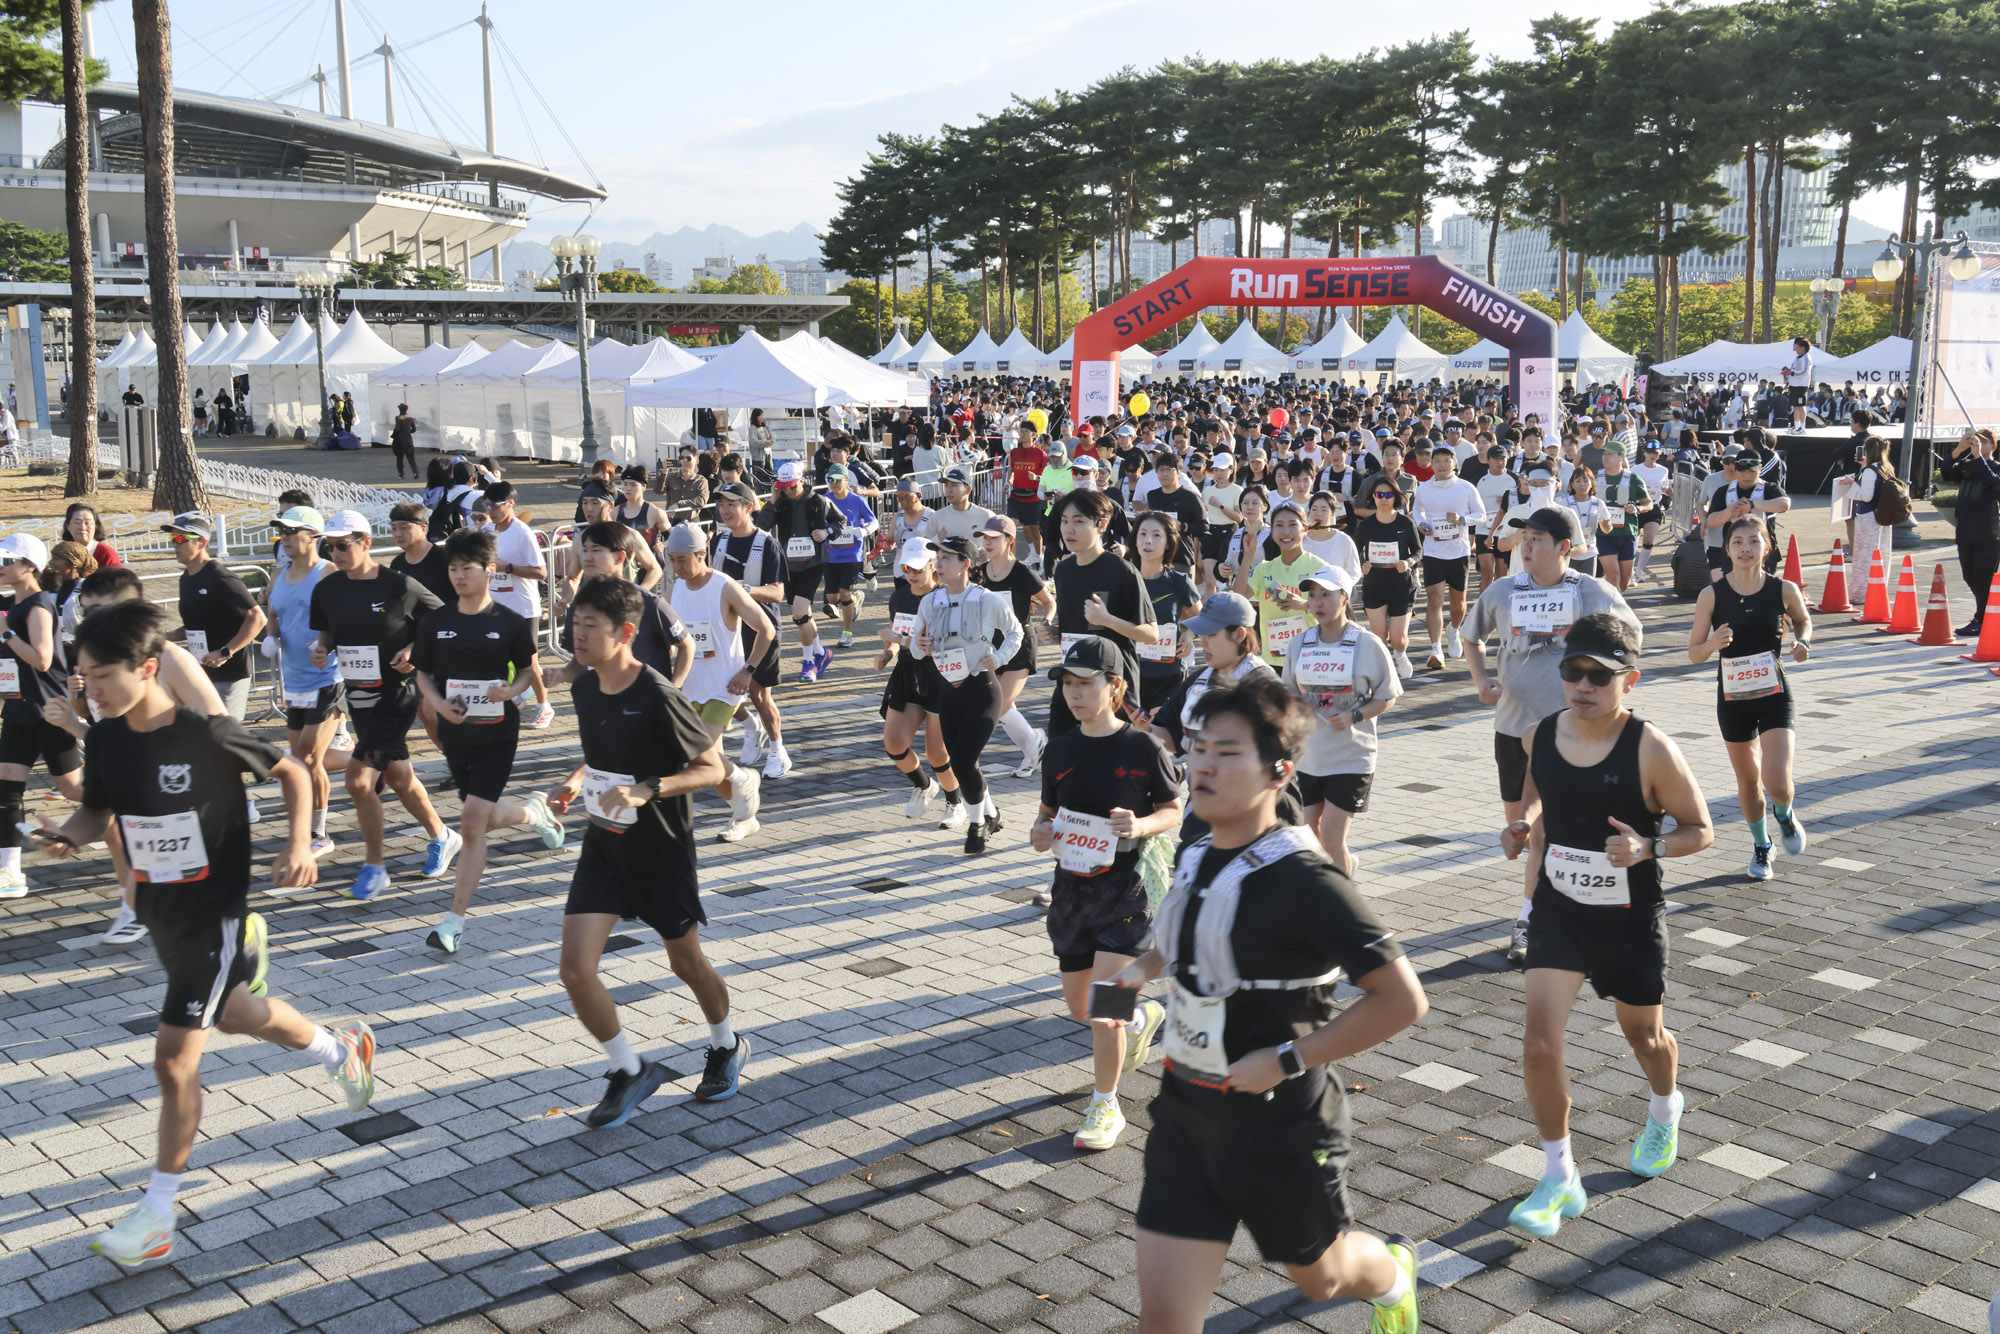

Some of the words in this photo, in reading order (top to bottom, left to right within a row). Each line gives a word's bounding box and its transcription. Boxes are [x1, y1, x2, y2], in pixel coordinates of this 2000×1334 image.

[1230, 268, 1299, 299] Run
[1113, 278, 1192, 336] START
[1441, 276, 1527, 334] FINISH
[1719, 372, 1758, 382] ROOM
[1856, 370, 1881, 382] MC
[1531, 602, 1564, 612] 1121
[349, 660, 374, 668] 1525
[938, 662, 962, 673] 2126
[1313, 662, 1345, 672] 2074
[0, 672, 16, 680] 089
[1737, 667, 1769, 681] 2553
[147, 836, 192, 852] 1237
[1066, 833, 1110, 853] 2082
[1555, 869, 1565, 880] M
[1569, 872, 1616, 888] 1325
